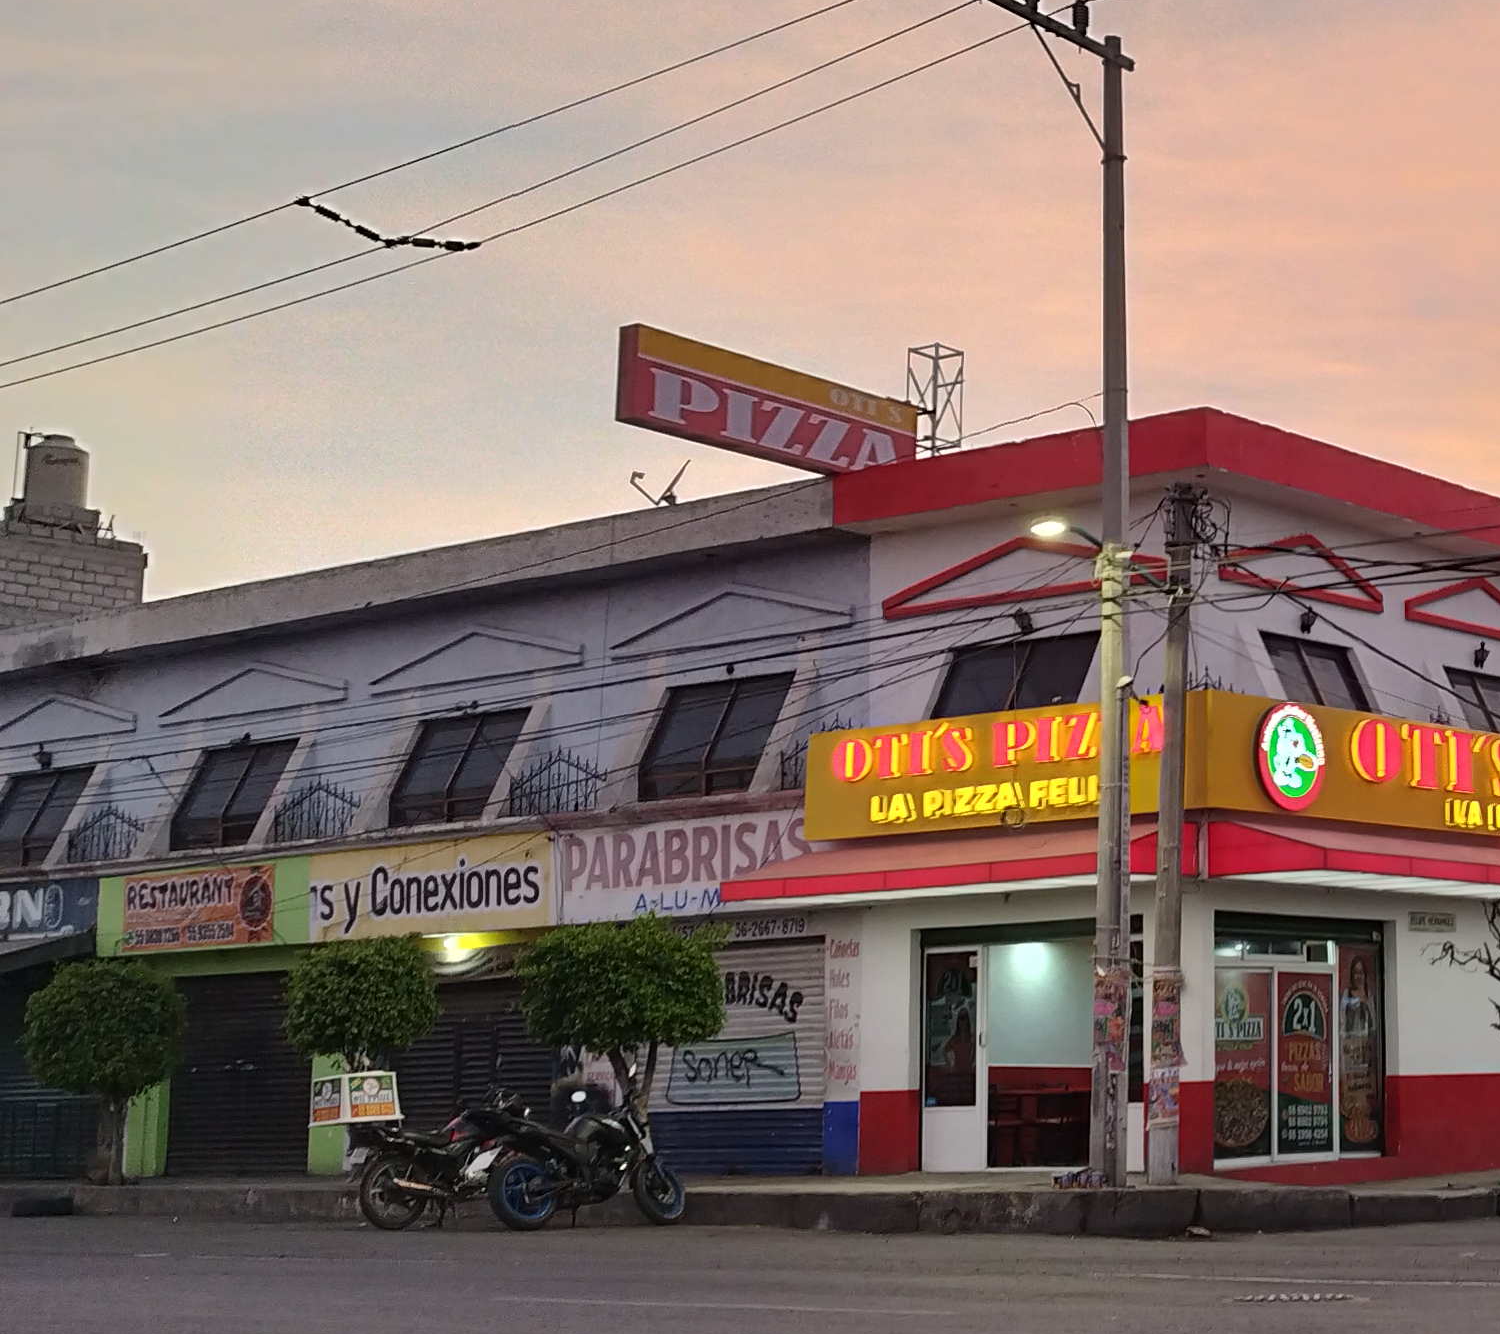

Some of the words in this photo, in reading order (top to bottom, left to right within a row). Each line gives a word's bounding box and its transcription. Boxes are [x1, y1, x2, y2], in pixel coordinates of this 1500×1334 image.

[648, 366, 898, 471] PIZZA
[831, 722, 974, 782] OTI'S
[991, 704, 1164, 768] PIZA
[869, 793, 917, 824] LA
[922, 781, 1022, 820] PIZZA
[1028, 774, 1099, 810] FELI
[126, 874, 234, 913] RESTAURANT
[344, 881, 361, 934] y
[370, 858, 540, 917] Conexiones
[1293, 997, 1316, 1034] 2x1
[1289, 1041, 1321, 1061] PIZZAS
